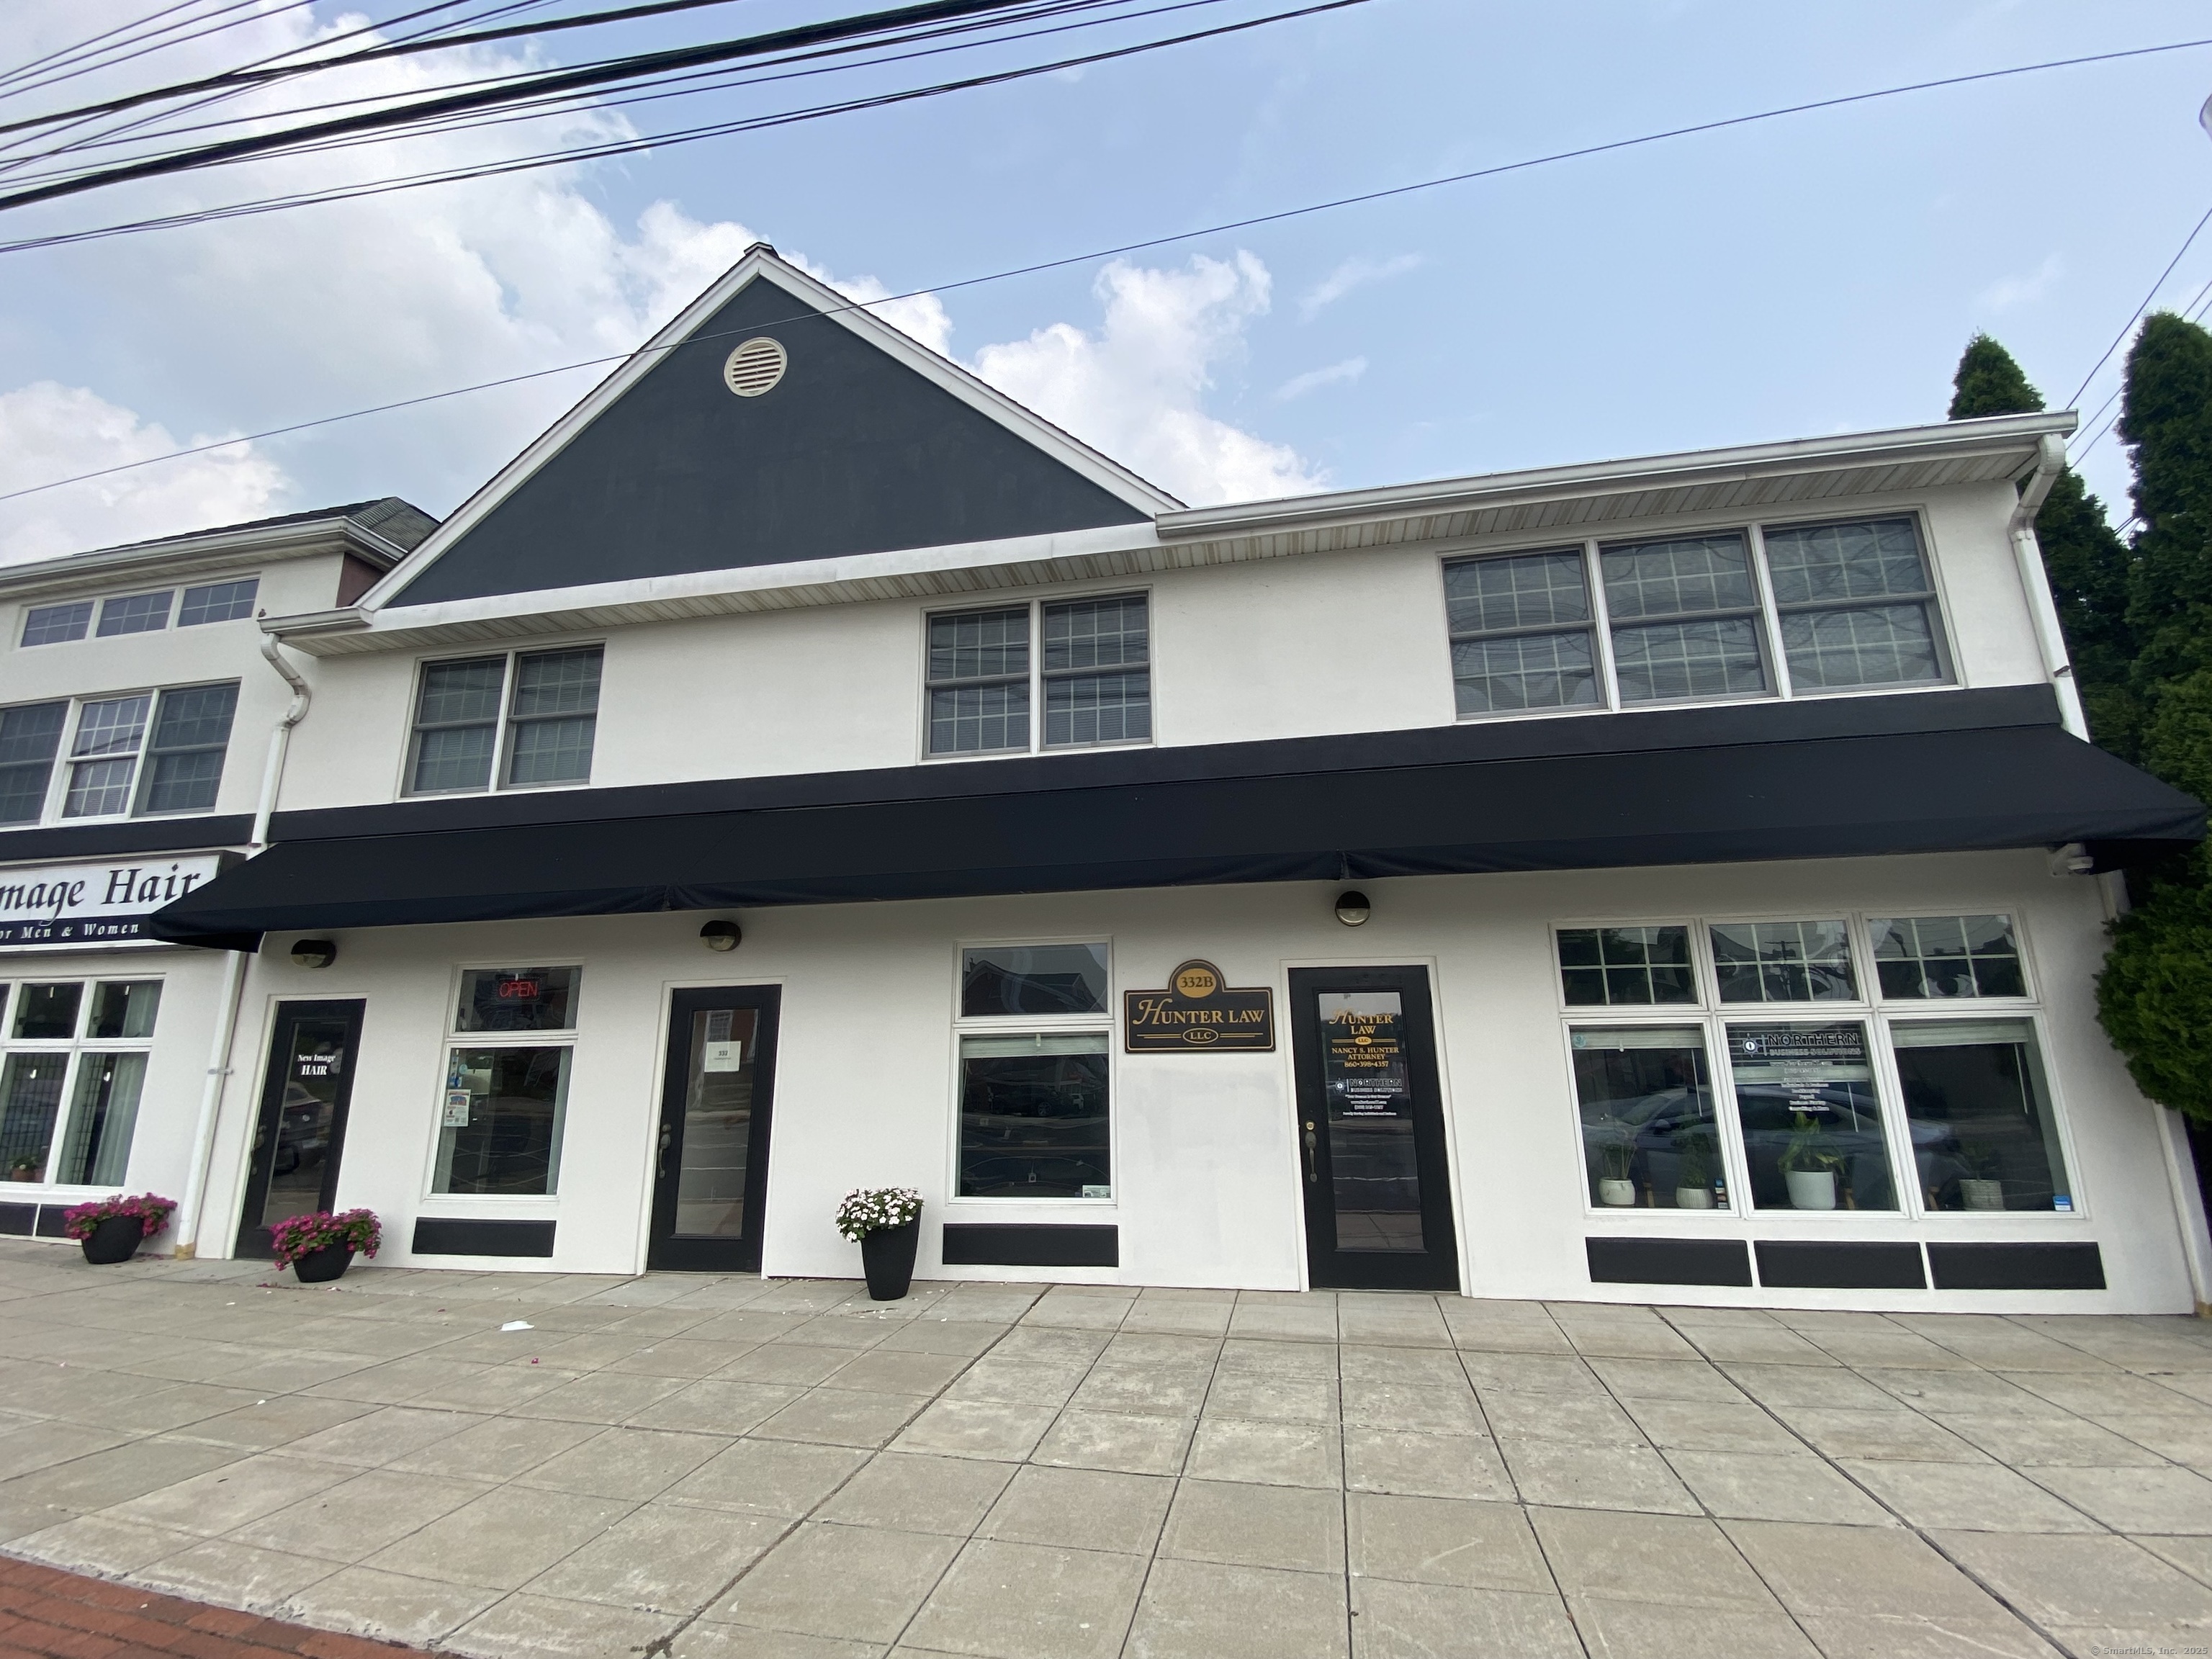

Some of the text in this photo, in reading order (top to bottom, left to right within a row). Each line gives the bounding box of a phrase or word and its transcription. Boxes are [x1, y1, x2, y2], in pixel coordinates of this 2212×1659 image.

[101, 863, 200, 904] Hair
[20, 927, 50, 939] Men
[61, 927, 73, 936] &
[84, 923, 139, 935] Women
[1180, 976, 1213, 988] 332B
[499, 981, 538, 997] OPEN
[1228, 1010, 1264, 1023] LAW
[1351, 1025, 1376, 1035] LAW
[1767, 1033, 1859, 1046] NORTHERN
[301, 1065, 327, 1075] HAIR
